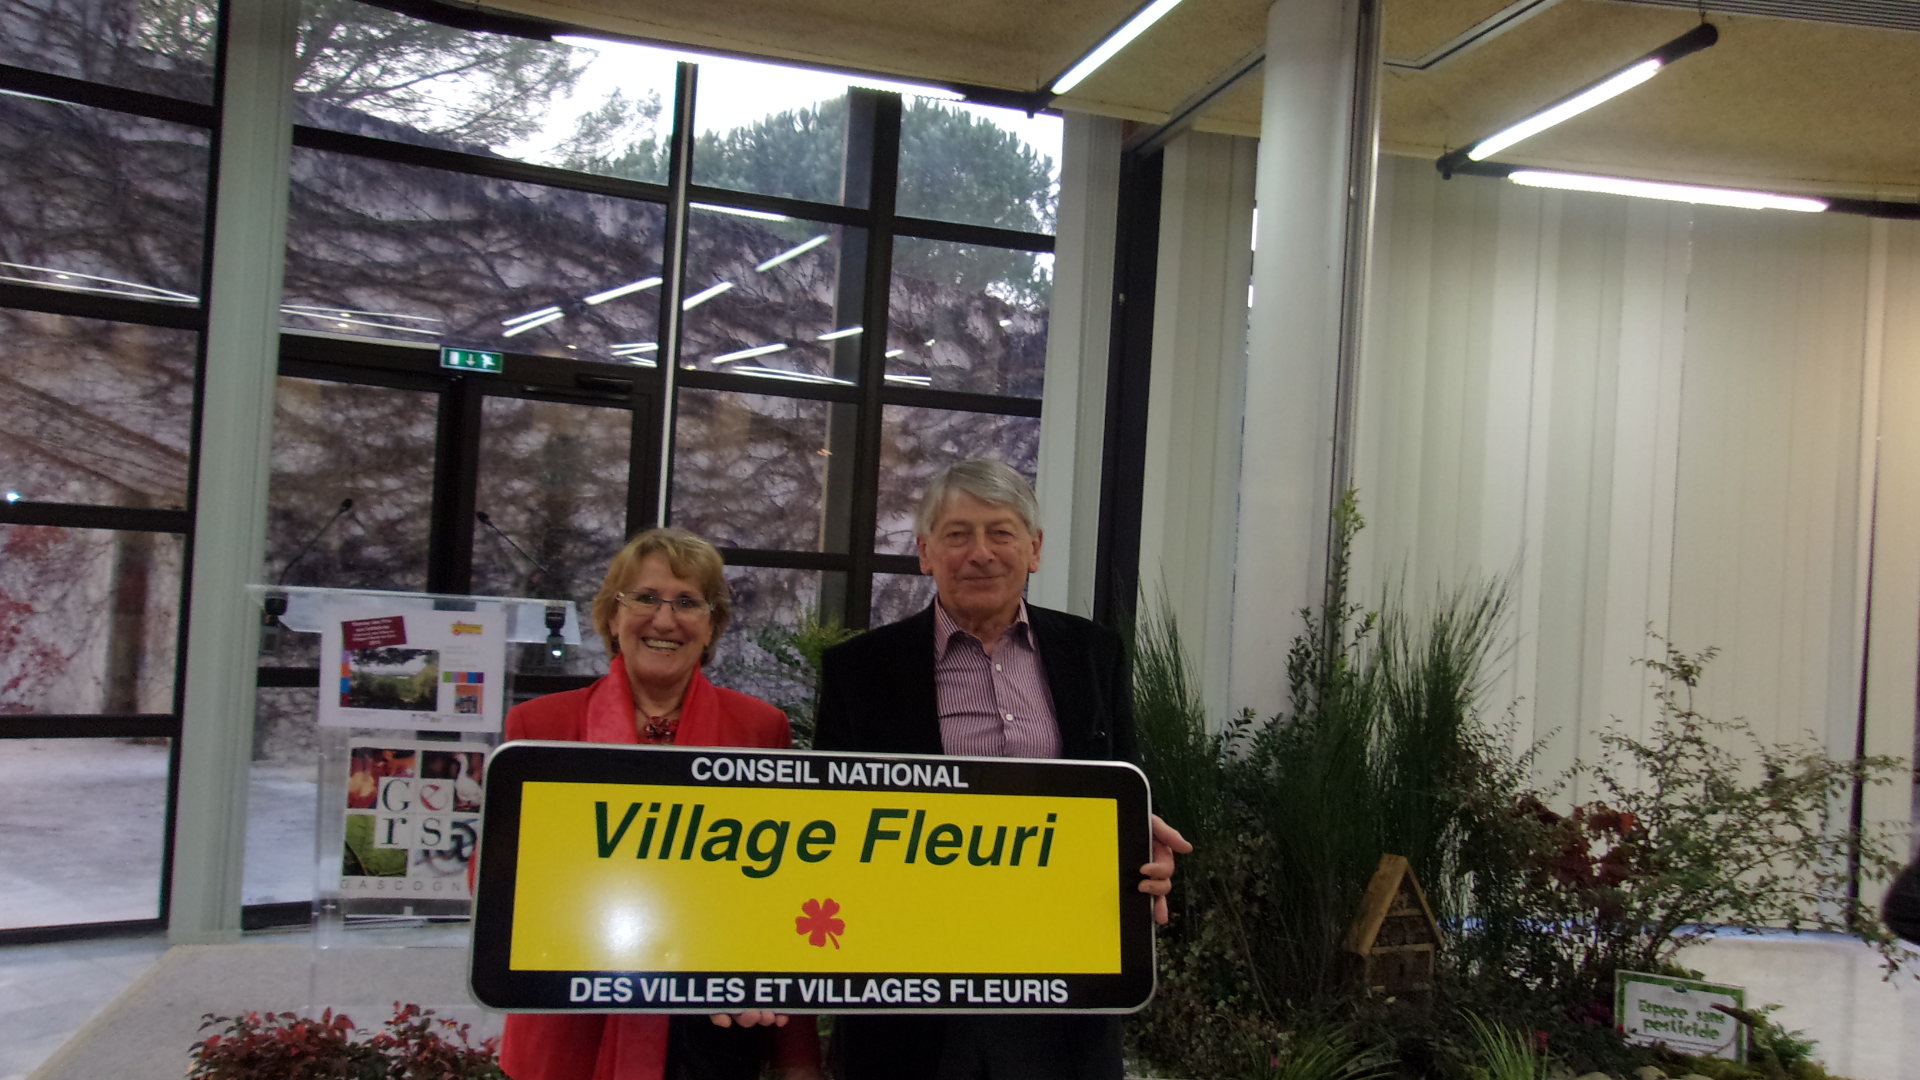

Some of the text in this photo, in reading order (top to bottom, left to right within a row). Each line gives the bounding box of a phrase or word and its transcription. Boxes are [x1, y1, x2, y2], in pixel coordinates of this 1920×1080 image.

[691, 757, 969, 788] CONSEIL NATIONAL
[594, 801, 1058, 879] Village Fleuri
[341, 880, 460, 891] GASCOGN
[570, 977, 1069, 1003] DES VILLES ET VILLAGES FLEURIS
[1643, 1019, 1720, 1040] pesticide
